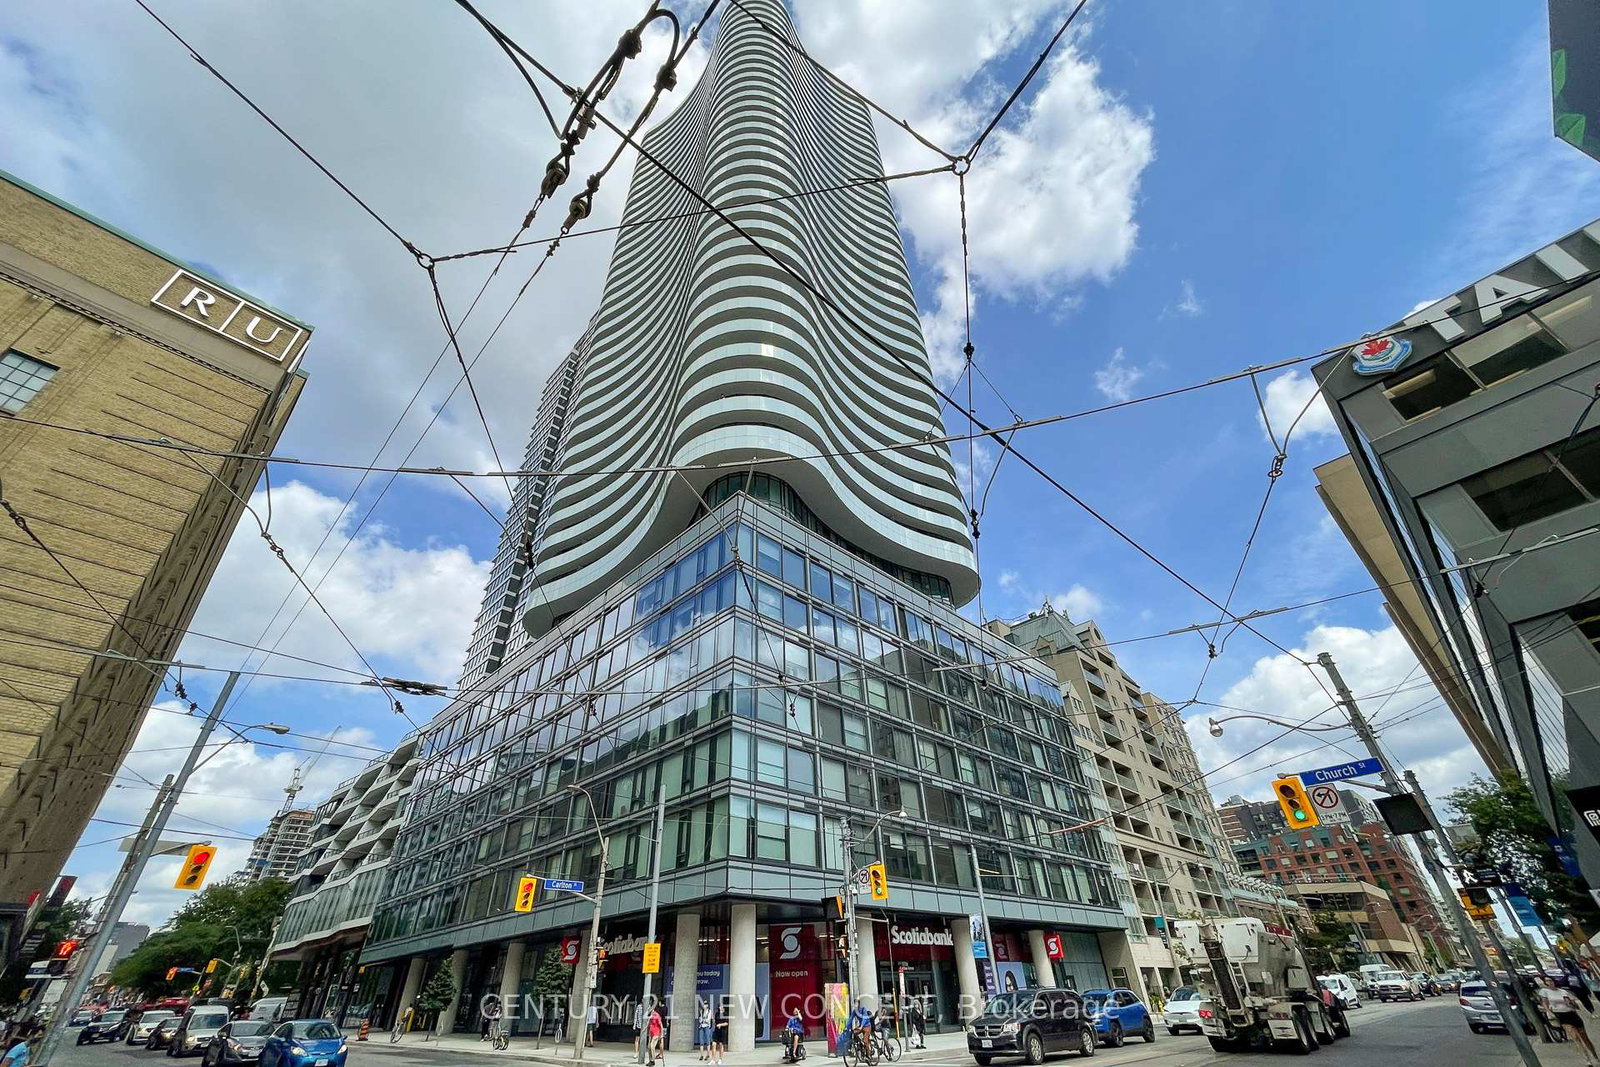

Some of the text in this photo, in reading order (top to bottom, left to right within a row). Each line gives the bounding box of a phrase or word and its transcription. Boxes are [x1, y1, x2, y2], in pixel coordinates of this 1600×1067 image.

[1315, 765, 1357, 781] Church
[891, 925, 954, 946] Scotiabank
[791, 970, 809, 979] open
